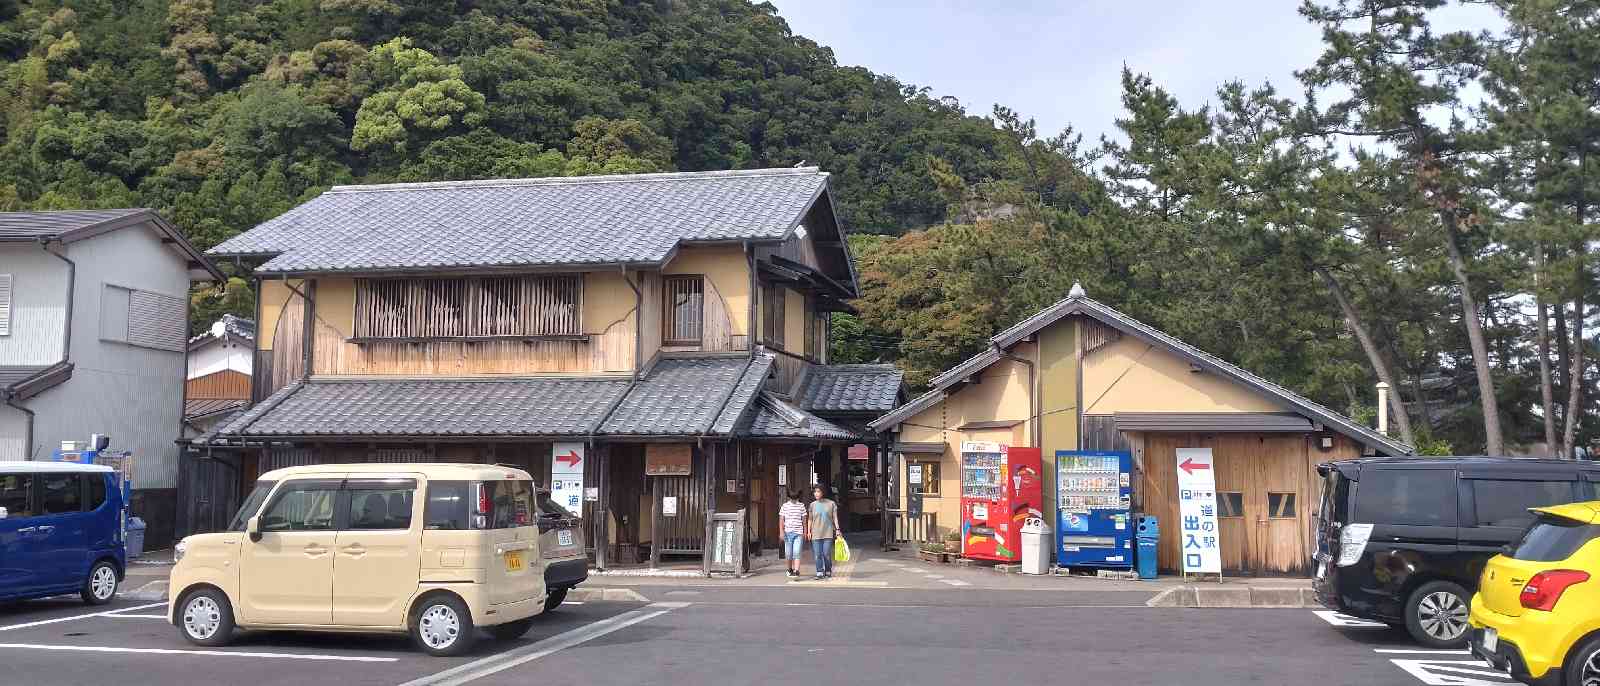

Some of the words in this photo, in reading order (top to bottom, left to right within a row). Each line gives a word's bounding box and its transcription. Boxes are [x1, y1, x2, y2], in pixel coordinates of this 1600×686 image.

[1184, 515, 1202, 568] 出入口
[1201, 504, 1215, 548] 道の駅
